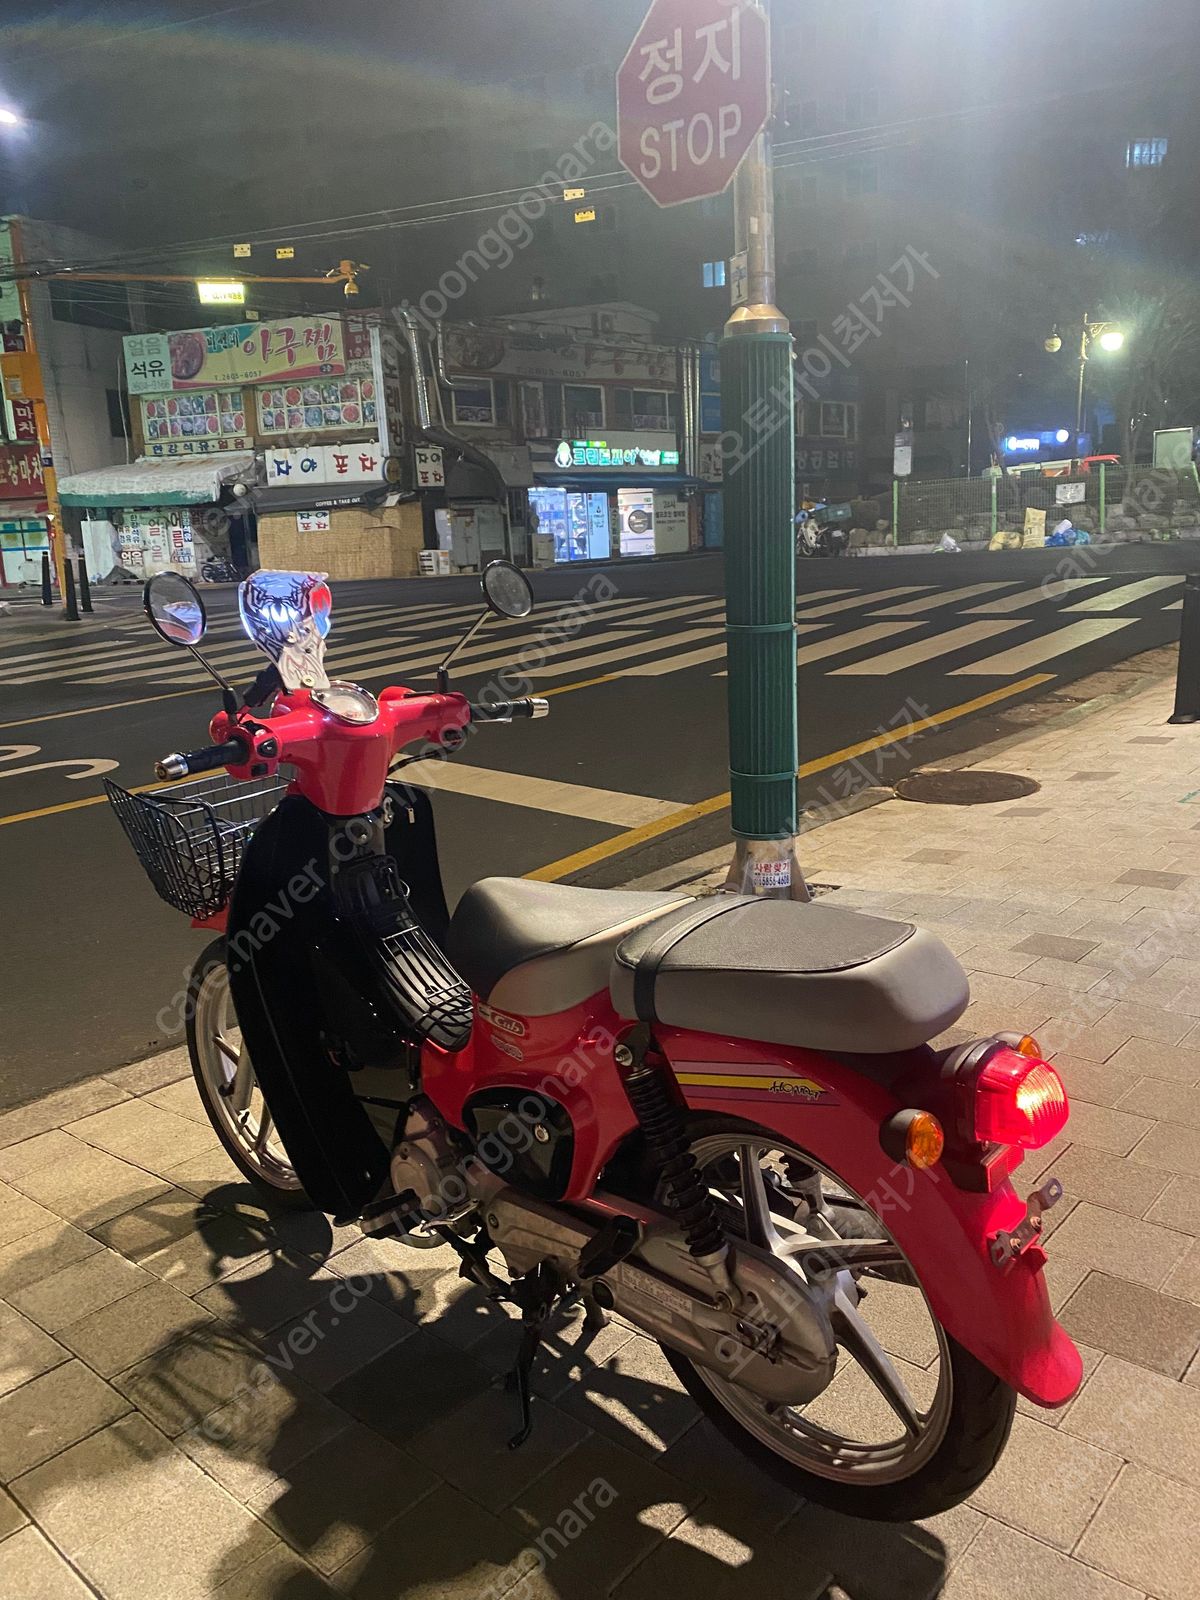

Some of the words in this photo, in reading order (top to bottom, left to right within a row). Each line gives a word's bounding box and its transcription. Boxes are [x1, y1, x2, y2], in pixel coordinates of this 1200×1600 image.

[638, 7, 741, 104] 정지
[640, 103, 742, 179] STOP
[243, 323, 337, 366] 아구찜
[131, 360, 165, 379] 석유
[494, 1015, 520, 1033] Cub
